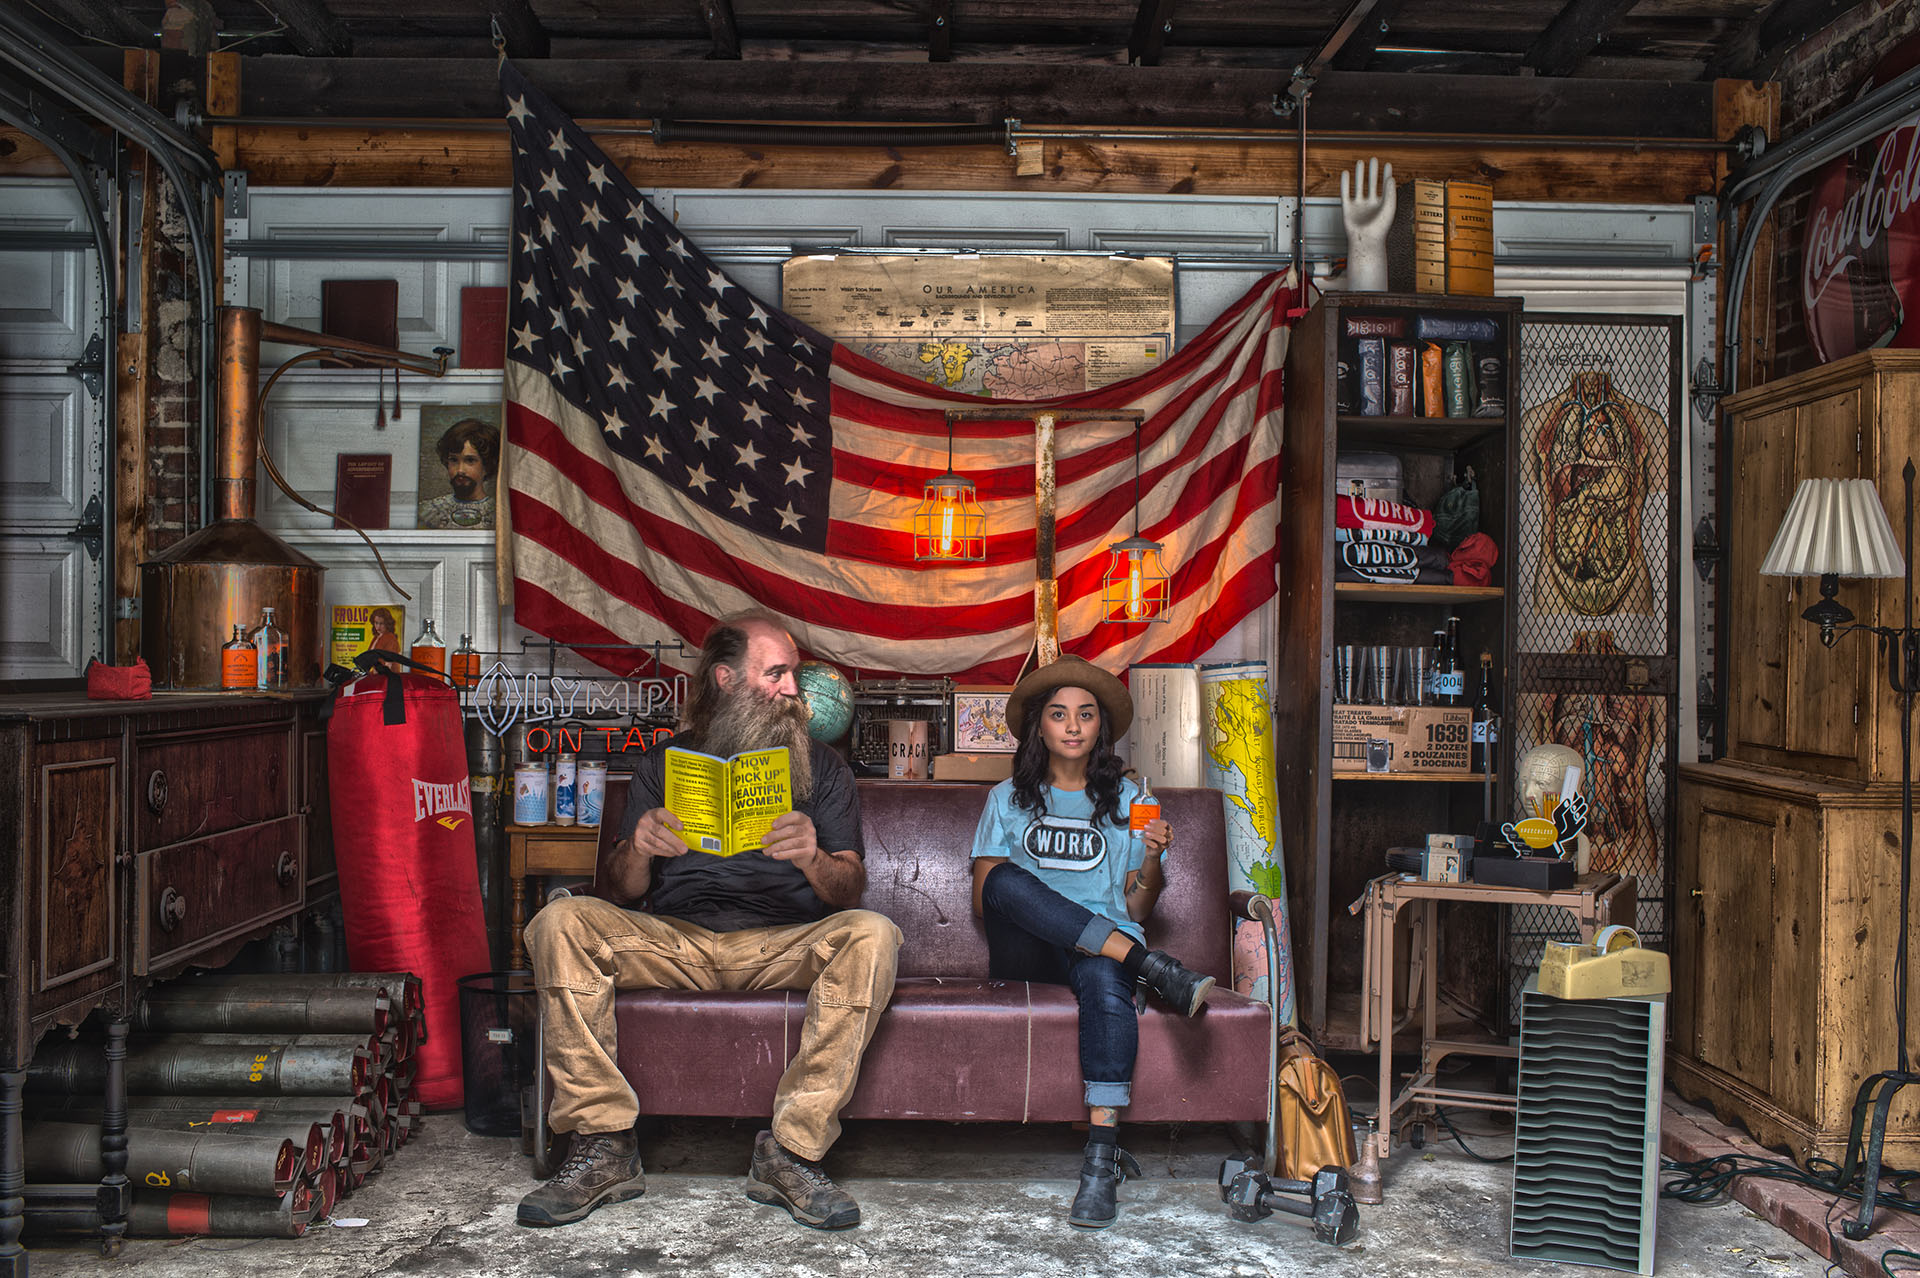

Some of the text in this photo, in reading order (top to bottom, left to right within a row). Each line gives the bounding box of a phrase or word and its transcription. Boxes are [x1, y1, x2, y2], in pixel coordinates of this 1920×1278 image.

[922, 284, 1036, 294] OUR AMERICA
[1363, 497, 1416, 523] WORK
[1354, 543, 1409, 565] WORK
[334, 607, 369, 623] FROLIC
[526, 727, 583, 754] ON
[1425, 723, 1468, 742] 1639
[891, 742, 927, 760] CRACK
[1412, 751, 1468, 759] DOUZAINES
[741, 755, 770, 769] HOW
[1413, 759, 1468, 768] 2 DOCENAS
[735, 770, 761, 785] PICK
[734, 783, 786, 800] EAUTIFUL
[735, 794, 783, 810] WOMEN
[1036, 828, 1095, 856] WORK
